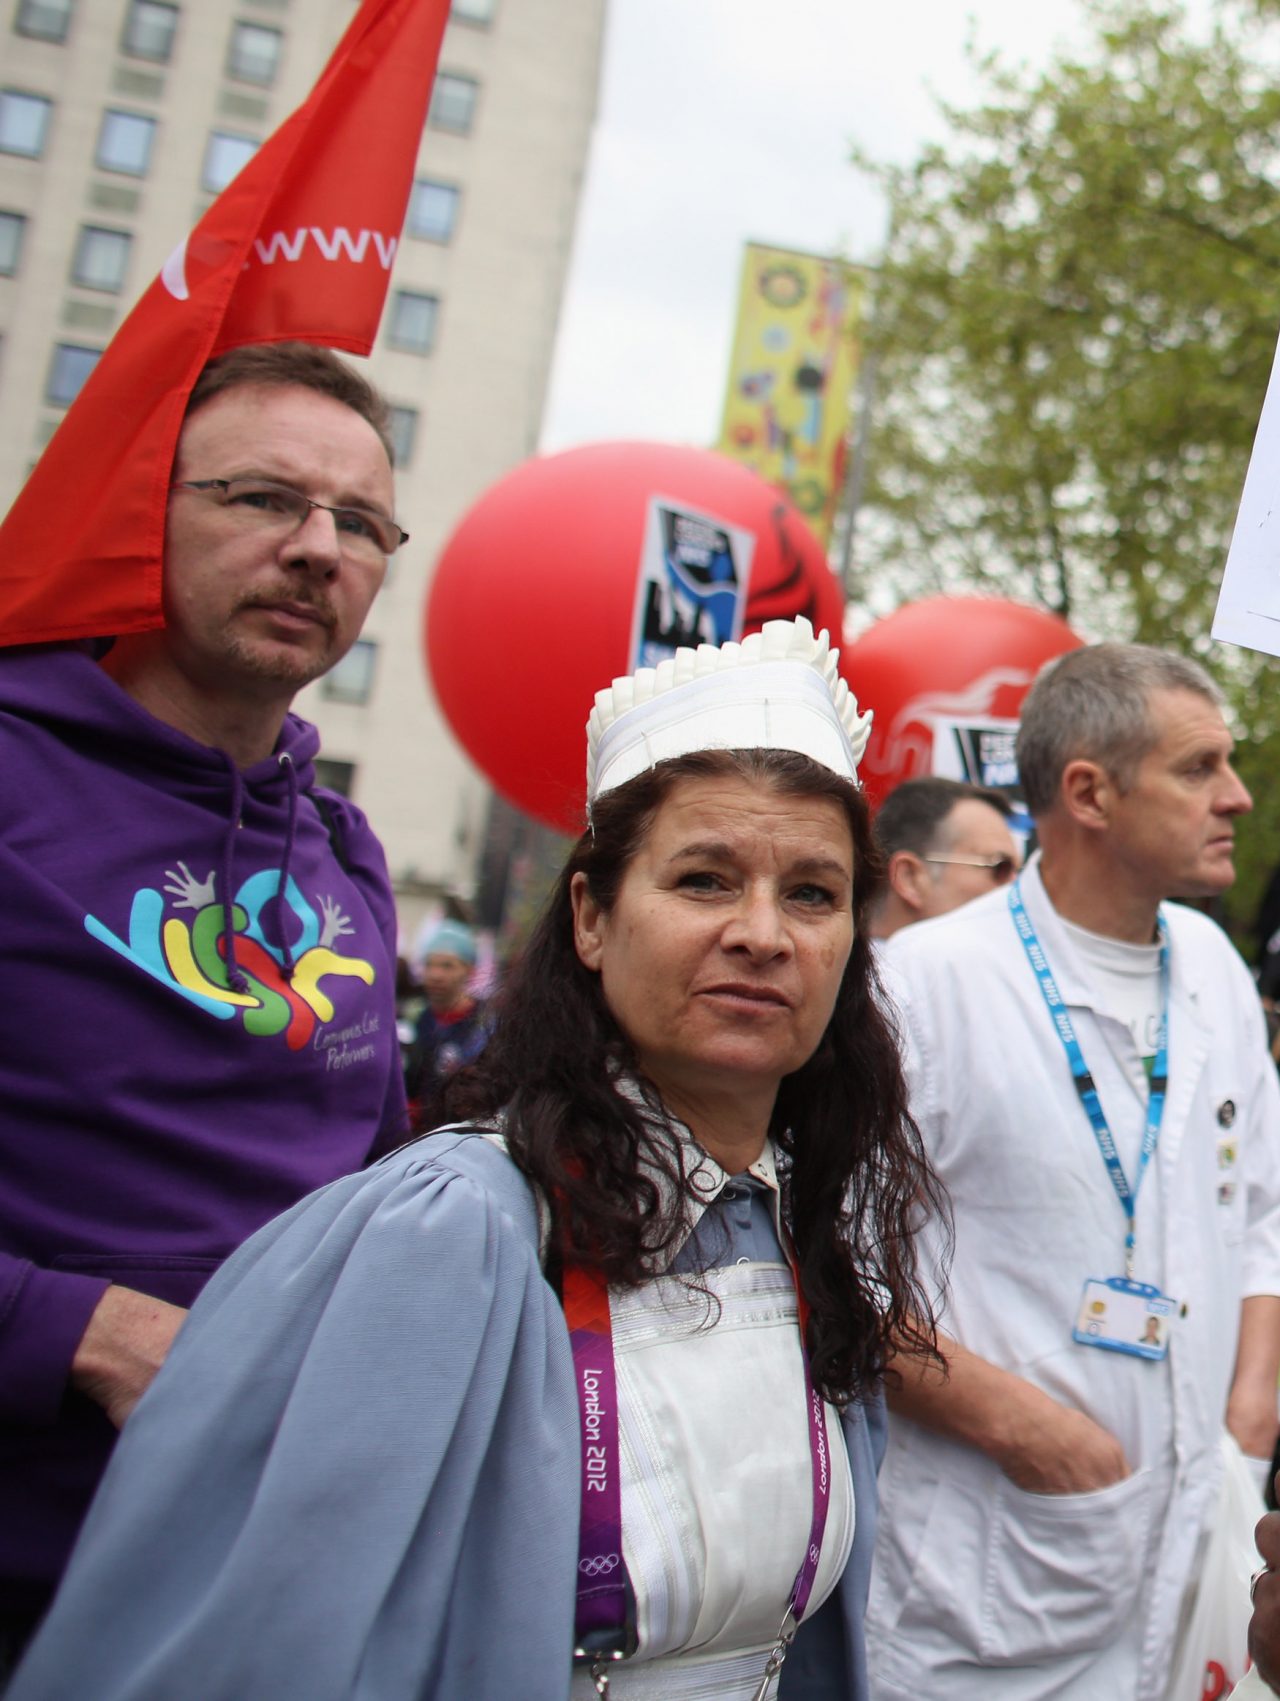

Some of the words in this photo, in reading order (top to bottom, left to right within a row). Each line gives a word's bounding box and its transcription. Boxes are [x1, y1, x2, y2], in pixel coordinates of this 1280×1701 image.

[1028, 943, 1048, 971] NHS
[1042, 977, 1061, 1006] NHS
[1055, 1013, 1075, 1043] NHS
[583, 1369, 606, 1441] London
[586, 1446, 608, 1492] 2012
[816, 1430, 828, 1495] London
